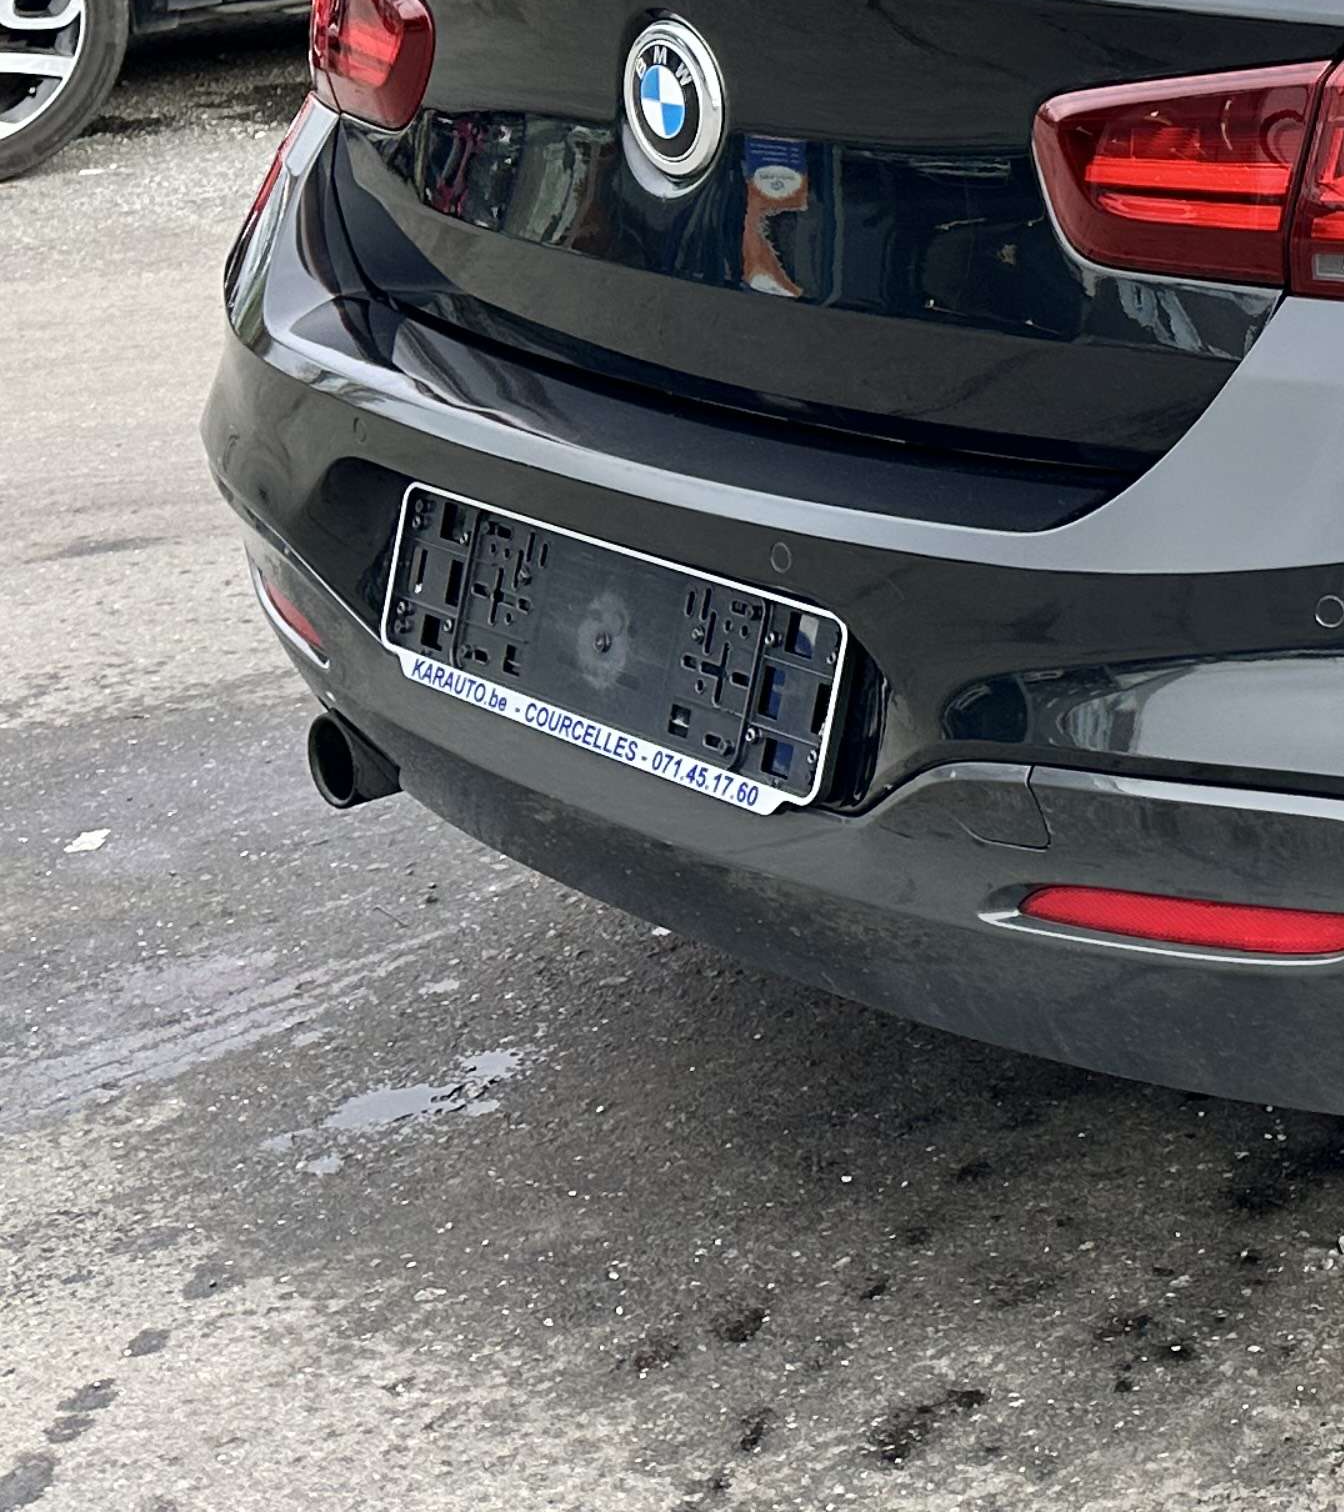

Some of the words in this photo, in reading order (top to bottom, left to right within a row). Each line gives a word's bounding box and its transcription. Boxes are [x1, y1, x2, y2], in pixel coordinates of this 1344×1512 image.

[635, 45, 693, 87] BMW
[411, 658, 508, 713] KARAUTO.be
[524, 702, 639, 762] COURCELLES
[652, 750, 759, 807] 071.45.17.60
